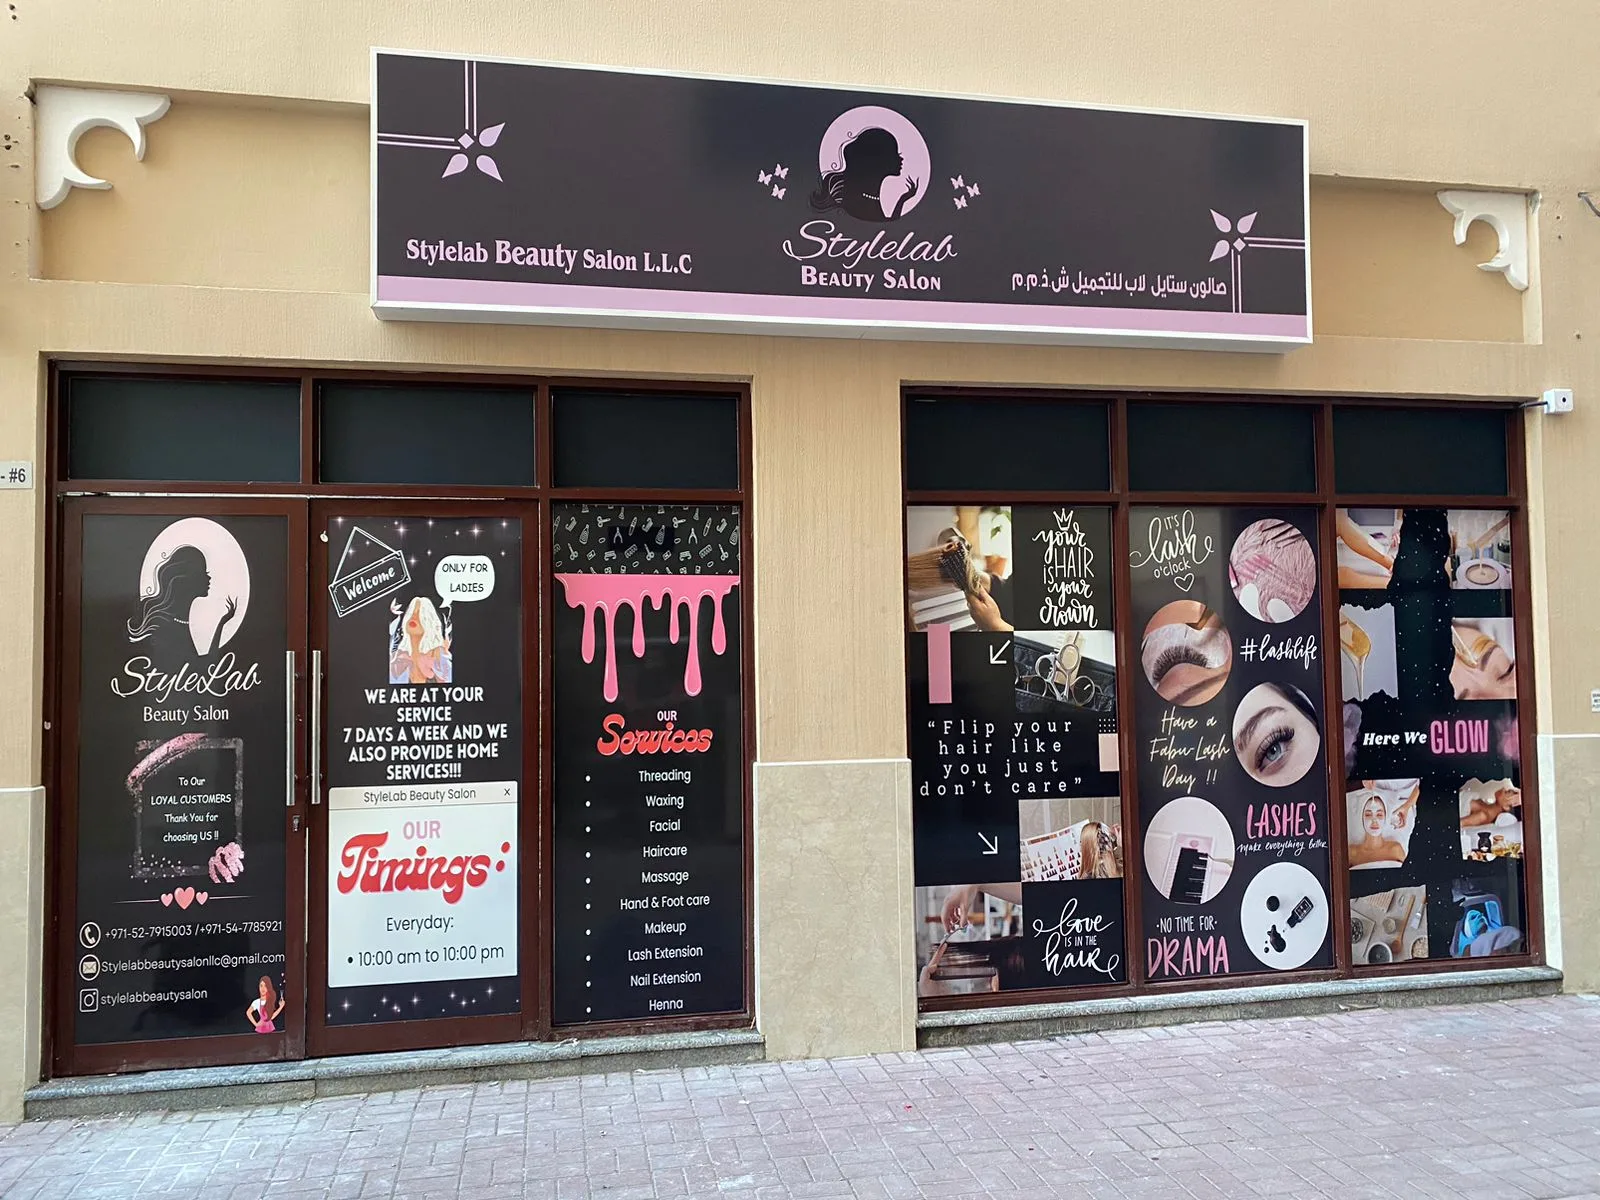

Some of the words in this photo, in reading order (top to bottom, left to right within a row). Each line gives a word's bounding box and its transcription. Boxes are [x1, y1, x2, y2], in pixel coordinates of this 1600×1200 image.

[783, 220, 957, 269] Stylelab
[406, 238, 489, 266] Stylelab
[495, 240, 578, 274] Beauty
[583, 249, 637, 271] Salon
[643, 252, 693, 274] L.L.C
[1072, 271, 1122, 295] للتجميل
[1125, 274, 1146, 296] لاب
[1151, 275, 1187, 298] ستايل
[1190, 277, 1227, 298] صالون
[9, 468, 26, 482] #6
[1164, 514, 1179, 530] IT'S
[1032, 522, 1086, 564] your
[1129, 509, 1215, 567] lash
[442, 564, 466, 572] ONLY
[470, 564, 488, 572] FOR
[1043, 565, 1054, 584] is
[1055, 547, 1094, 578] HAIR
[1154, 557, 1191, 578] o'clock
[343, 567, 395, 600] Welcome
[450, 583, 484, 592] LADIES
[1048, 579, 1093, 607] your
[1040, 597, 1098, 628] crown
[1240, 634, 1317, 670] #lashlife
[110, 652, 262, 703] StyleLab
[365, 689, 386, 704] WE
[390, 688, 416, 703] ARE
[420, 688, 438, 702] AT
[443, 687, 484, 701] YOUR
[143, 707, 189, 725] Beauty
[194, 706, 229, 721] Salon
[397, 706, 452, 722] SERVICE
[657, 710, 677, 721] OUR
[1161, 706, 1198, 735] Have
[1206, 716, 1217, 727] a
[343, 728, 352, 743] 7
[356, 727, 393, 742] DAYS
[397, 727, 407, 741] A
[411, 725, 448, 740] WEEK
[453, 724, 483, 739] AND
[487, 724, 507, 738] WE
[597, 714, 713, 756] Services
[1014, 721, 1071, 736] your
[1363, 732, 1400, 746] Here
[1404, 732, 1427, 744] We
[1430, 719, 1488, 754] GLOW
[349, 746, 386, 762] ALSO
[391, 744, 453, 760] PROVIDE
[457, 743, 499, 758] HOME
[939, 740, 992, 754] hair
[1012, 738, 1061, 753] like
[1150, 734, 1230, 762] Fabu-Lash
[386, 763, 461, 780] SERVICES!!!
[639, 769, 691, 784] Threading
[944, 764, 987, 779] you
[1005, 759, 1058, 777] just
[179, 777, 188, 786] To
[191, 777, 205, 786] Our
[1162, 764, 1196, 794] Day
[1206, 769, 1218, 785] !!
[151, 796, 178, 805] LOYAL
[180, 794, 232, 804] CUSTOMERS
[363, 791, 407, 804] StyleLab
[410, 789, 445, 802] Beauty
[447, 788, 476, 799] Salon
[646, 794, 684, 809] Waxing
[165, 814, 188, 823] Thank
[189, 813, 204, 822] You
[206, 813, 219, 822] for
[650, 819, 681, 832] Facial
[1246, 802, 1316, 839] LASHES
[163, 832, 198, 843] choosing
[200, 832, 212, 841] US
[403, 821, 441, 840] OUR
[643, 845, 688, 858] Haircare
[1236, 843, 1261, 856] make
[1265, 840, 1305, 857] everything
[642, 870, 689, 884] Massage
[620, 897, 648, 910] Hand
[651, 897, 659, 908] &
[662, 896, 683, 907] Foot
[686, 895, 710, 906] care
[386, 915, 454, 934] Everyday:
[1032, 898, 1115, 938] love
[1160, 918, 1172, 933] NO
[1175, 917, 1194, 932] TIME
[1199, 916, 1214, 930] FOR
[105, 925, 192, 939] +971-52-7915003
[645, 921, 687, 935] Makeup
[1065, 936, 1072, 947] IS
[1074, 936, 1083, 946] IN
[1085, 935, 1097, 946] THE
[359, 951, 393, 966] 10:00
[397, 951, 421, 964] am
[425, 949, 439, 962] to
[443, 946, 476, 961] 10:00
[481, 946, 504, 963] pm
[628, 948, 652, 961] Lash
[655, 945, 703, 959] Extension
[1148, 936, 1230, 977] DRAMA
[101, 953, 285, 974] Stylelabbeautysalonllc@gmail.com
[630, 974, 650, 987] Nail
[653, 971, 701, 985] Extension
[100, 989, 208, 1005] stylelabbeautysalon
[649, 999, 683, 1011] Henna
